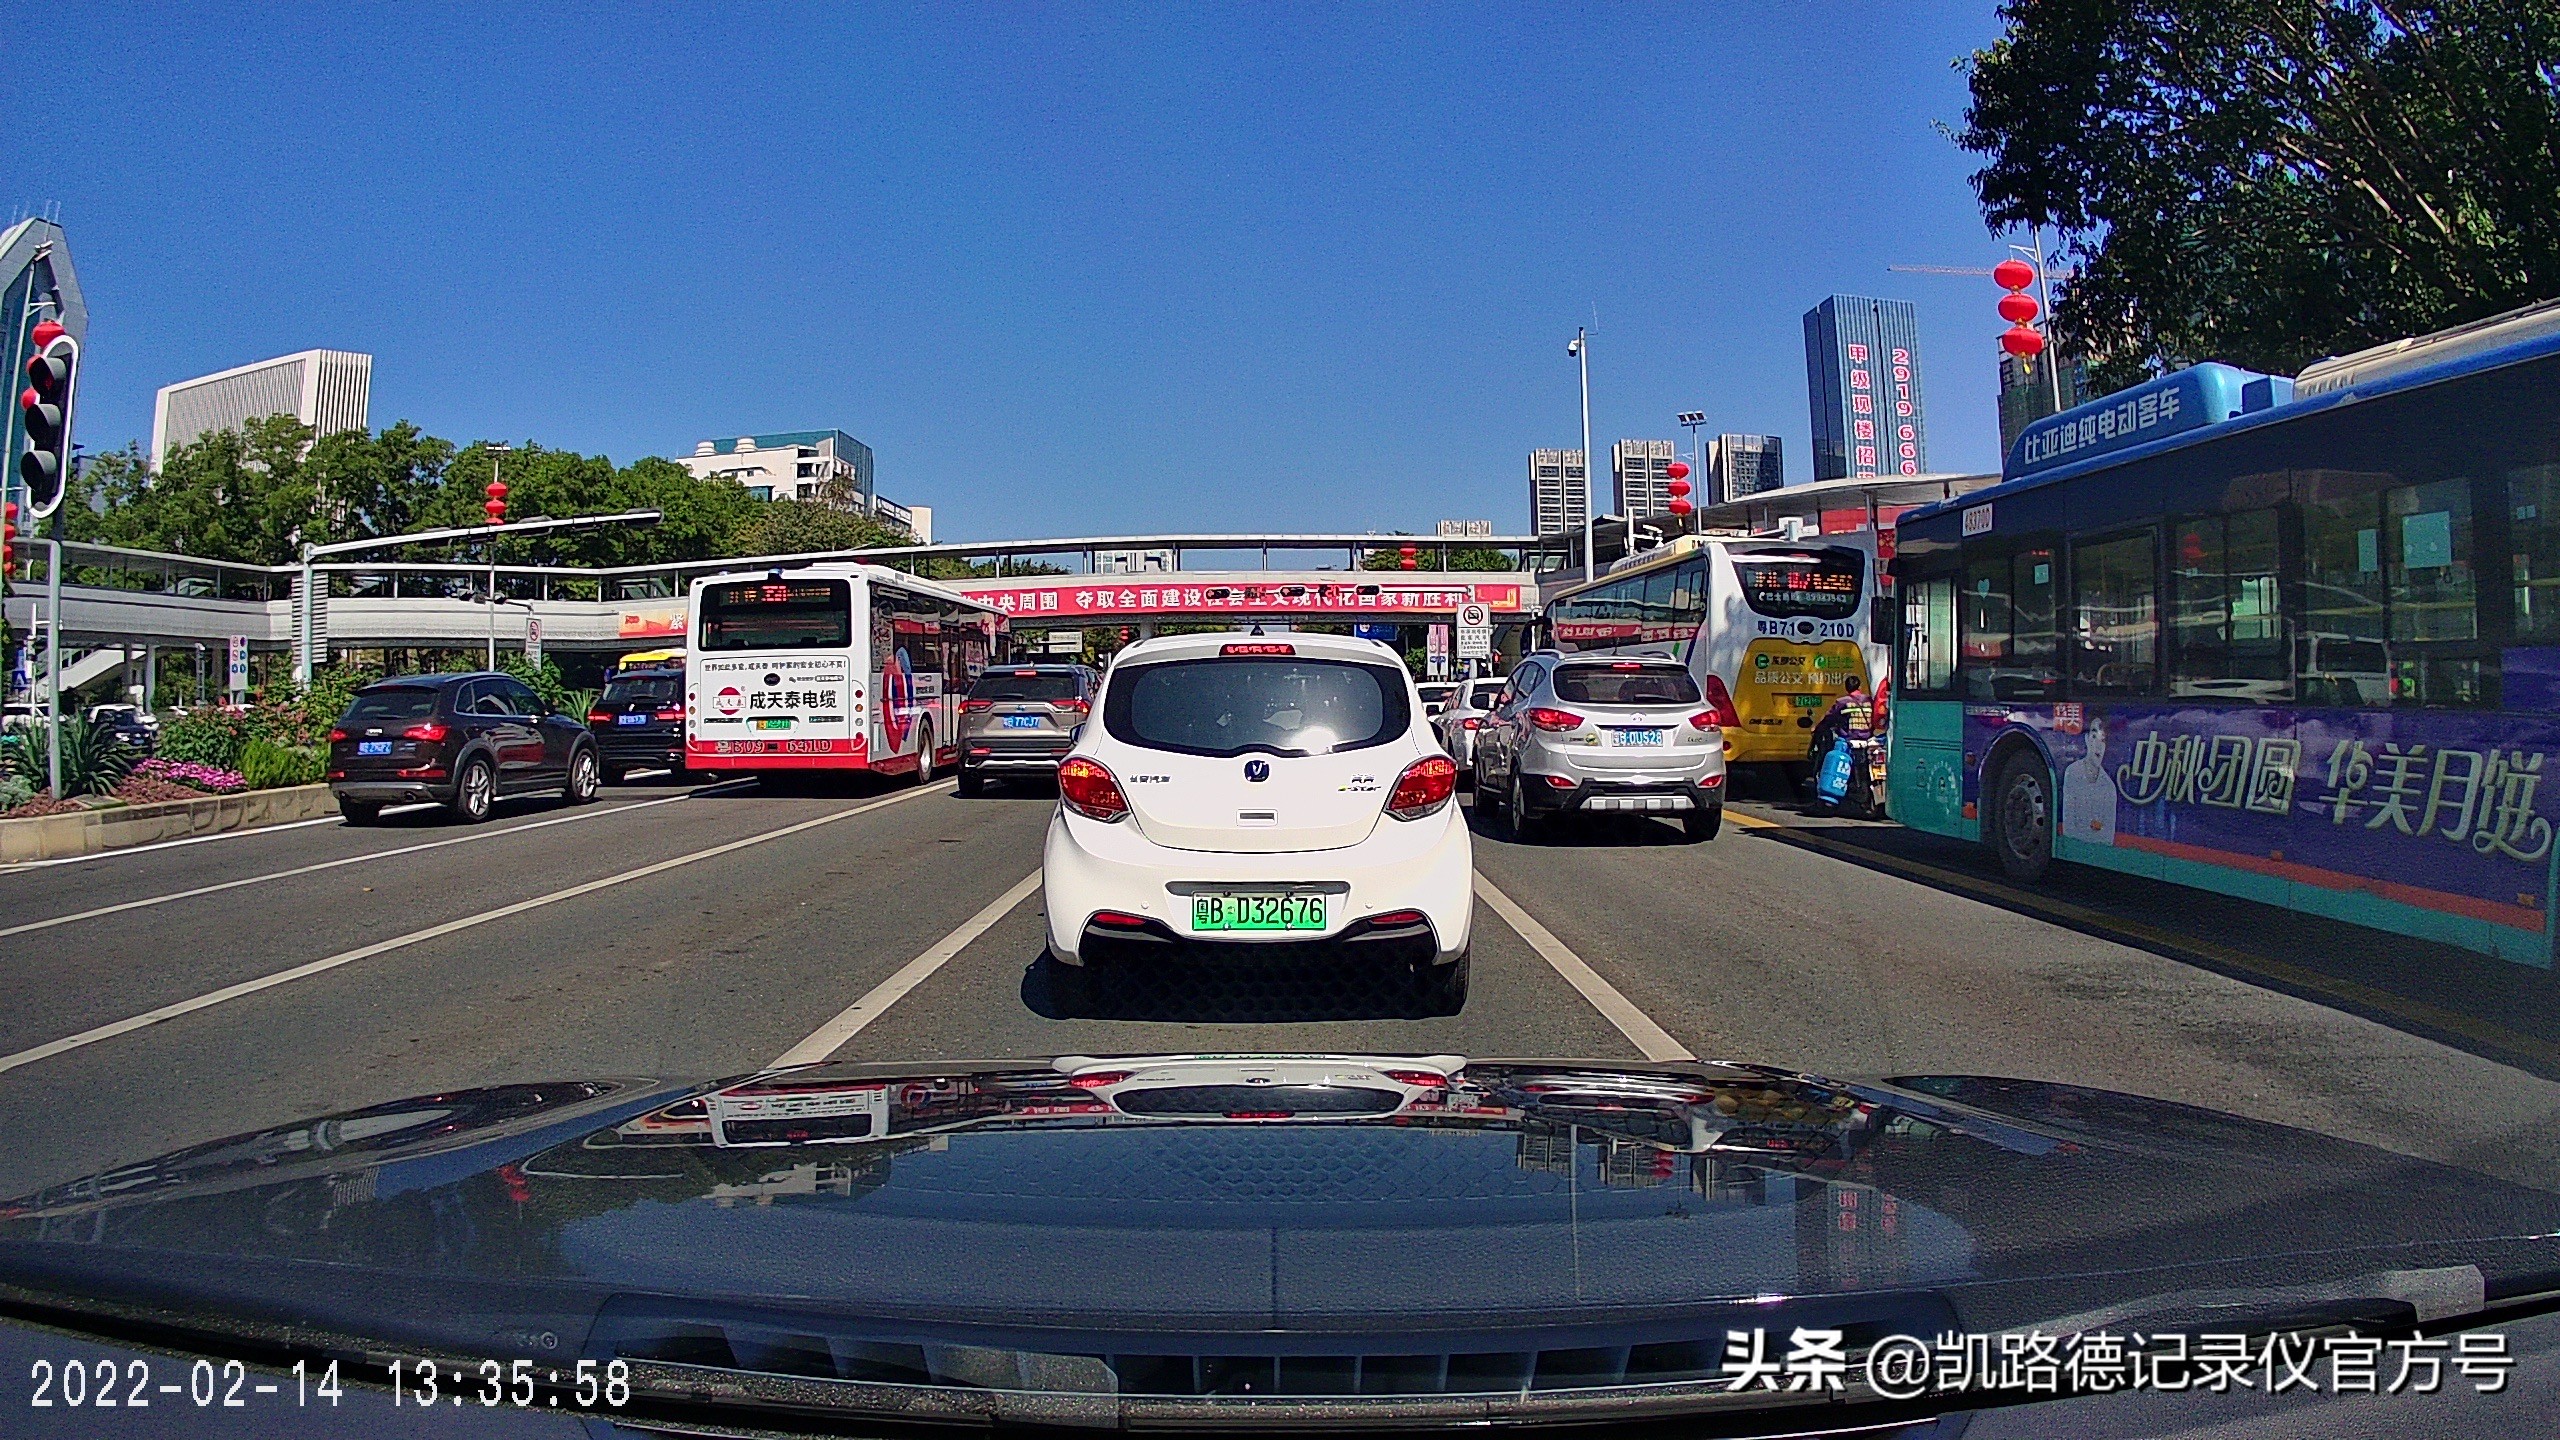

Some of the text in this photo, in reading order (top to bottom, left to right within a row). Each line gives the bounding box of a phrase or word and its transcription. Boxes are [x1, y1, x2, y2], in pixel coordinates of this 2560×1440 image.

[2024, 386, 2180, 465] 比亚迪纯电动客车
[1820, 623, 1854, 638] 210D
[1754, 671, 1804, 685] 品质公交
[750, 690, 838, 709] 成天泰电缆
[786, 740, 832, 753] 641D
[2116, 730, 2552, 862] 中秋团圆 华美月饼
